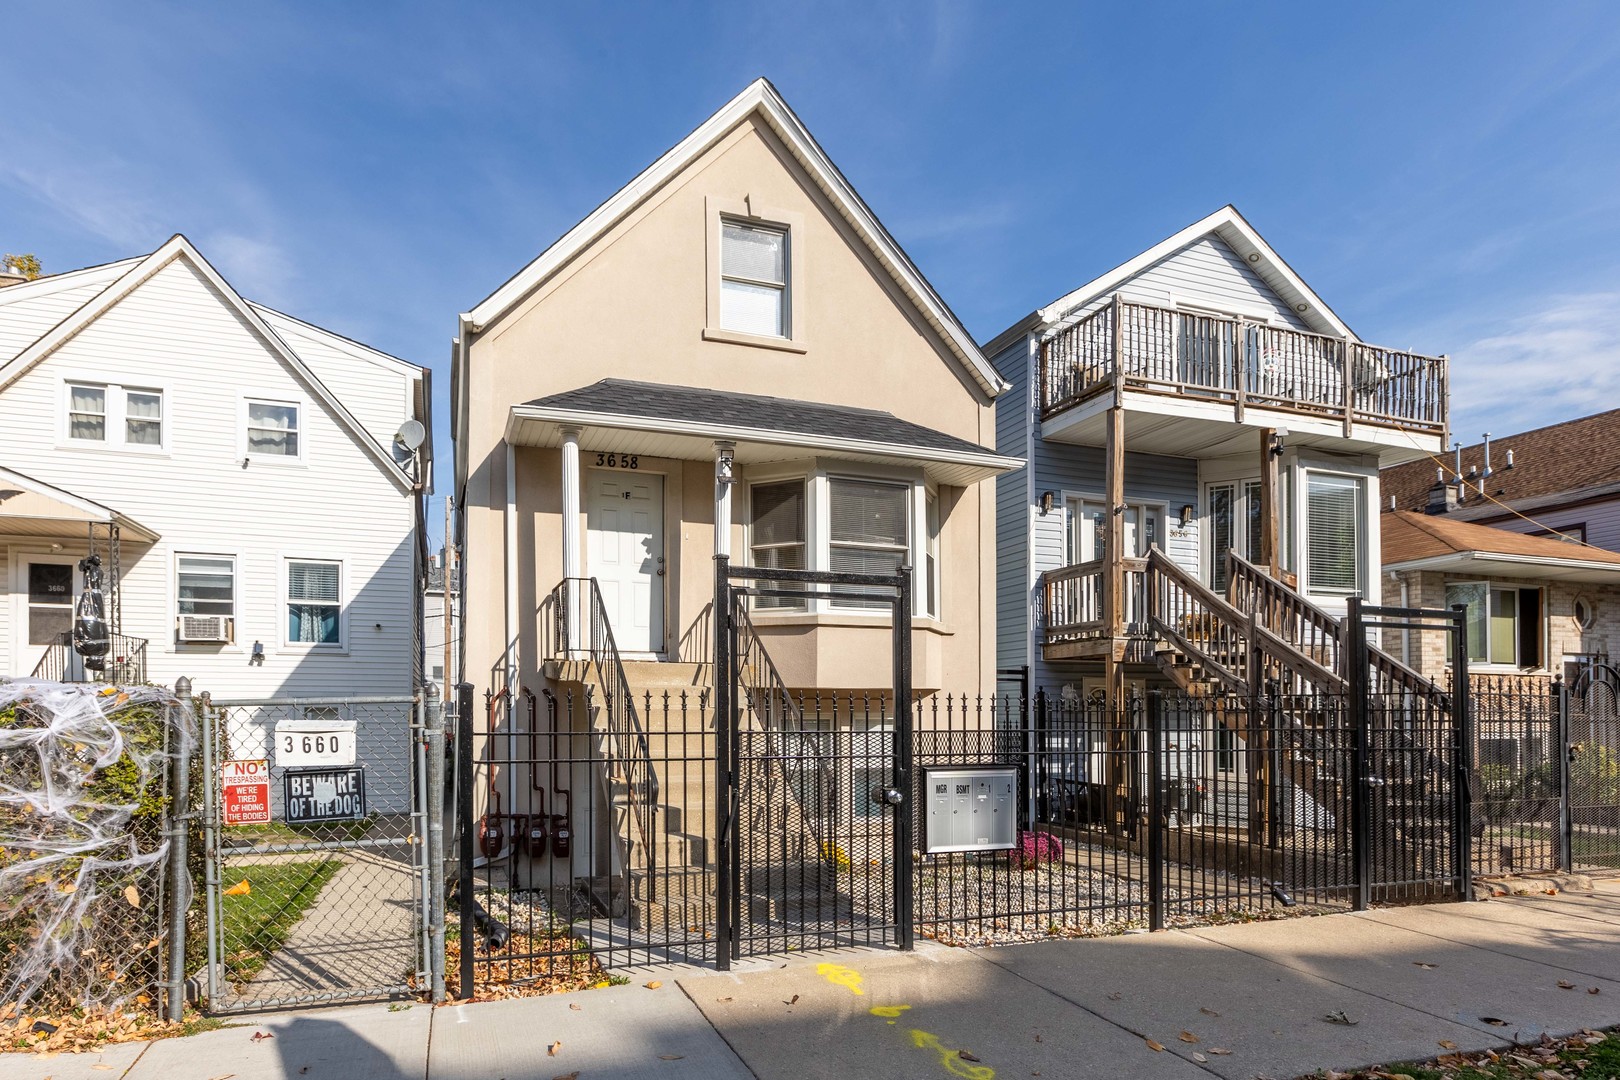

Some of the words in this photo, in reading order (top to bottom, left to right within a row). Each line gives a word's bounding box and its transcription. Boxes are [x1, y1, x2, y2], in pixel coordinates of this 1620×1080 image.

[596, 454, 638, 469] 3658
[284, 736, 339, 753] 3660
[235, 763, 258, 775] NO
[225, 775, 268, 784] TRESPASSING
[236, 786, 257, 794] WE'RE
[936, 784, 947, 794] MGR
[956, 785, 970, 794] BSMT
[988, 784, 991, 793] 1
[1007, 784, 1011, 793] 2
[237, 795, 257, 803] TIRED
[231, 804, 241, 812] OF
[241, 803, 264, 811] HIDING
[290, 798, 306, 818] OF
[309, 798, 333, 817] THE
[333, 794, 360, 816] DOG
[228, 813, 242, 821] THE
[242, 812, 268, 820] BODIES
